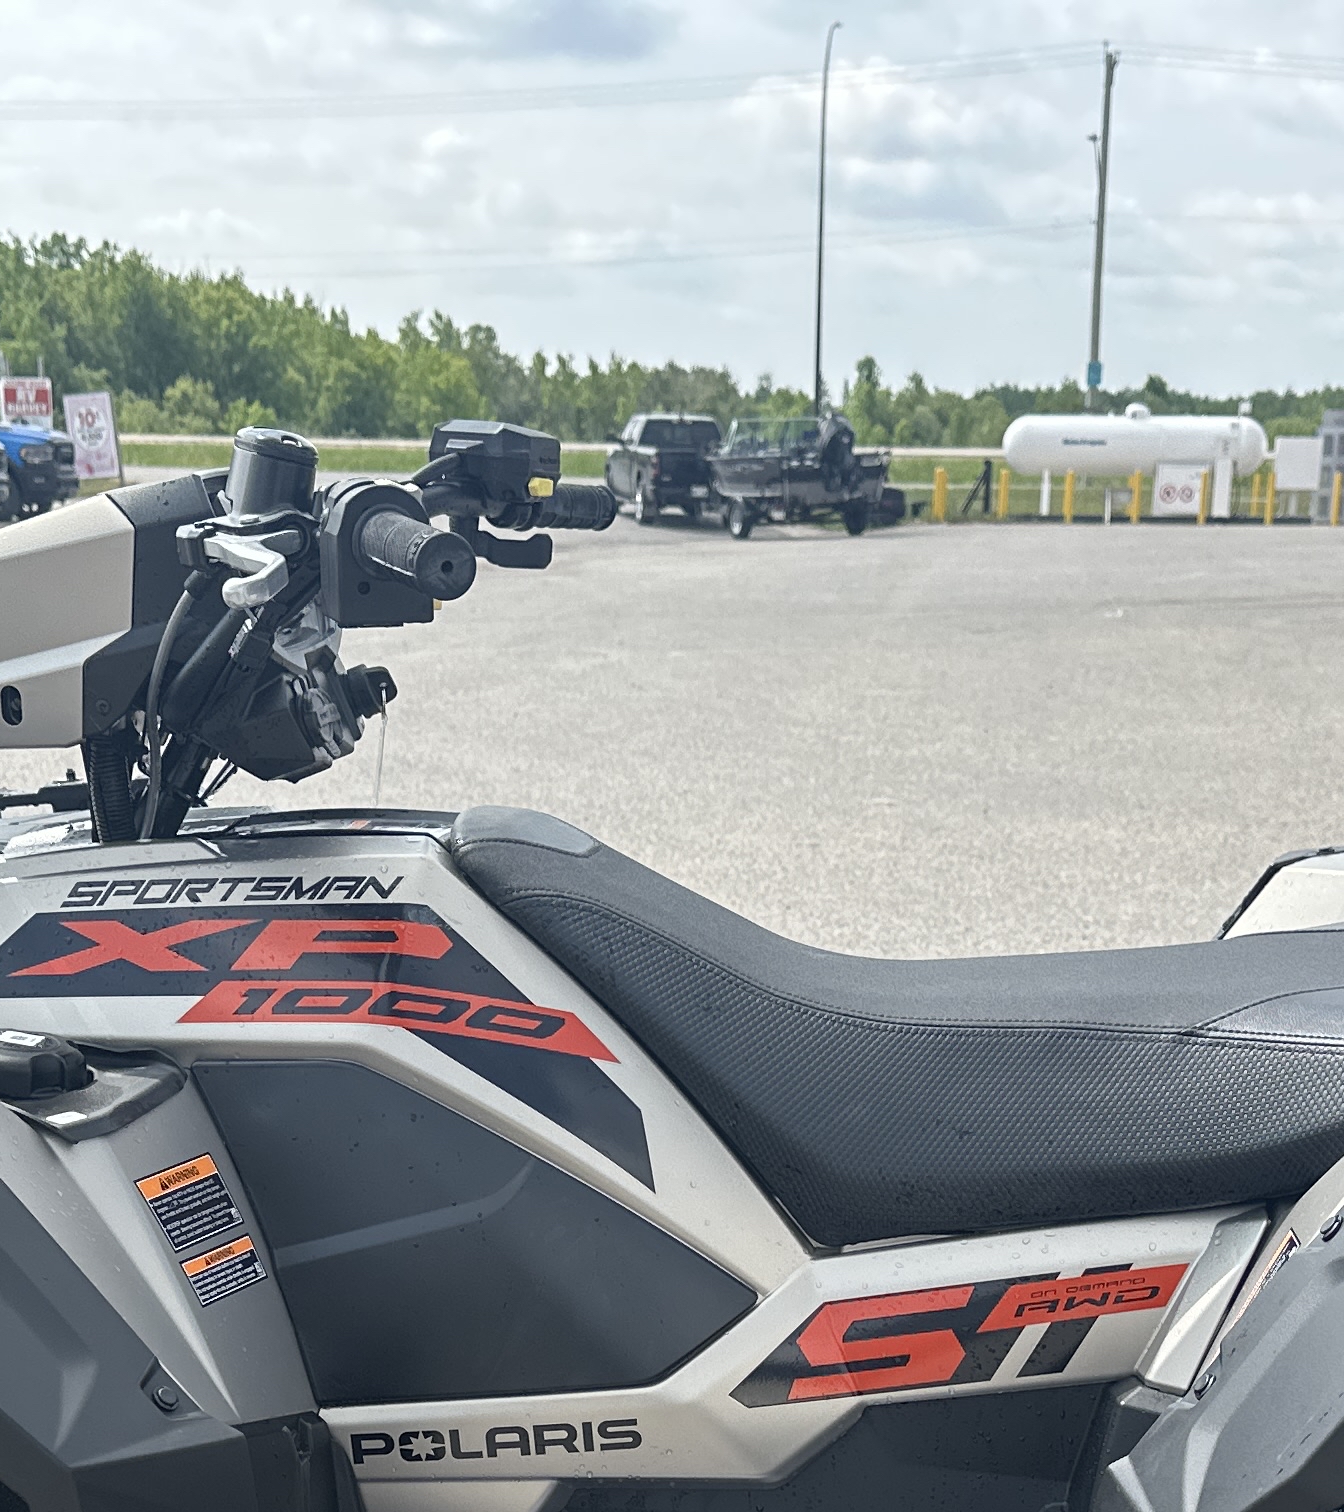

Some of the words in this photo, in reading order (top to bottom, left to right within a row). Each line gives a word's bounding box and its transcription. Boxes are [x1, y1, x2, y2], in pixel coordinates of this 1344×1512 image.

[61, 876, 404, 908] SPORTSMAN
[6, 918, 455, 978] XP
[233, 987, 567, 1040] 1000
[167, 1165, 200, 1186] WARNING
[1014, 1286, 1161, 1318] AWD
[1030, 1288, 1058, 1299] ON
[1065, 1277, 1146, 1294] DEMAND
[351, 1418, 643, 1466] POLARIS
